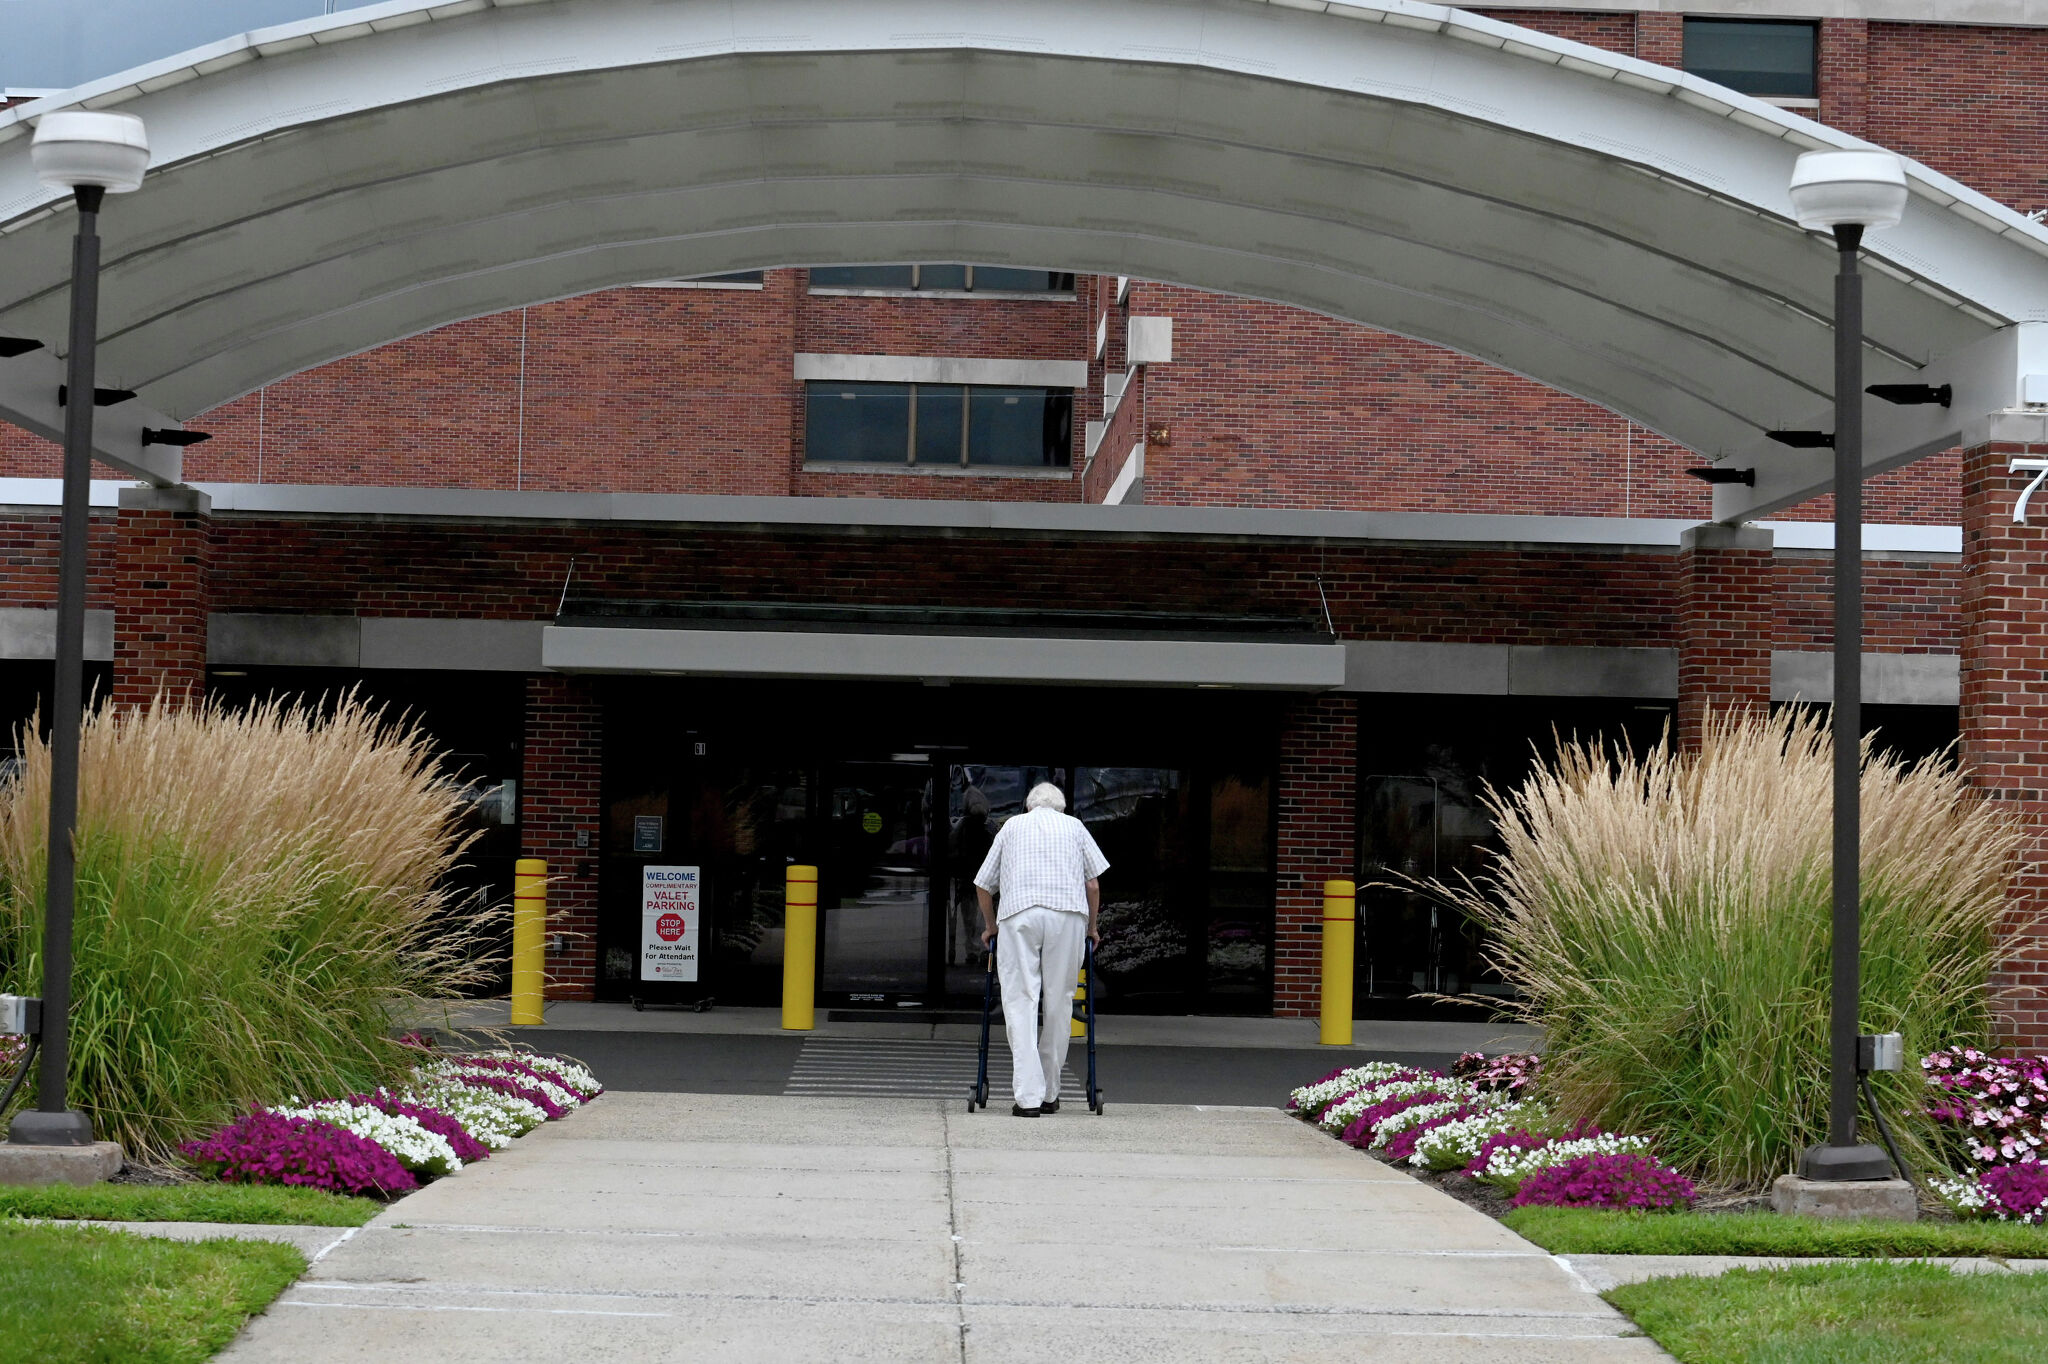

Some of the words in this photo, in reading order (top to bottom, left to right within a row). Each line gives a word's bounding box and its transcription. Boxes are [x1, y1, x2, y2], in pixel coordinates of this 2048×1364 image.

[646, 872, 696, 881] WELCOME
[654, 891, 689, 900] VALET
[646, 900, 695, 911] PARKING
[660, 919, 681, 927] STOP
[660, 928, 681, 936] HERE
[659, 953, 695, 961] Attendant
